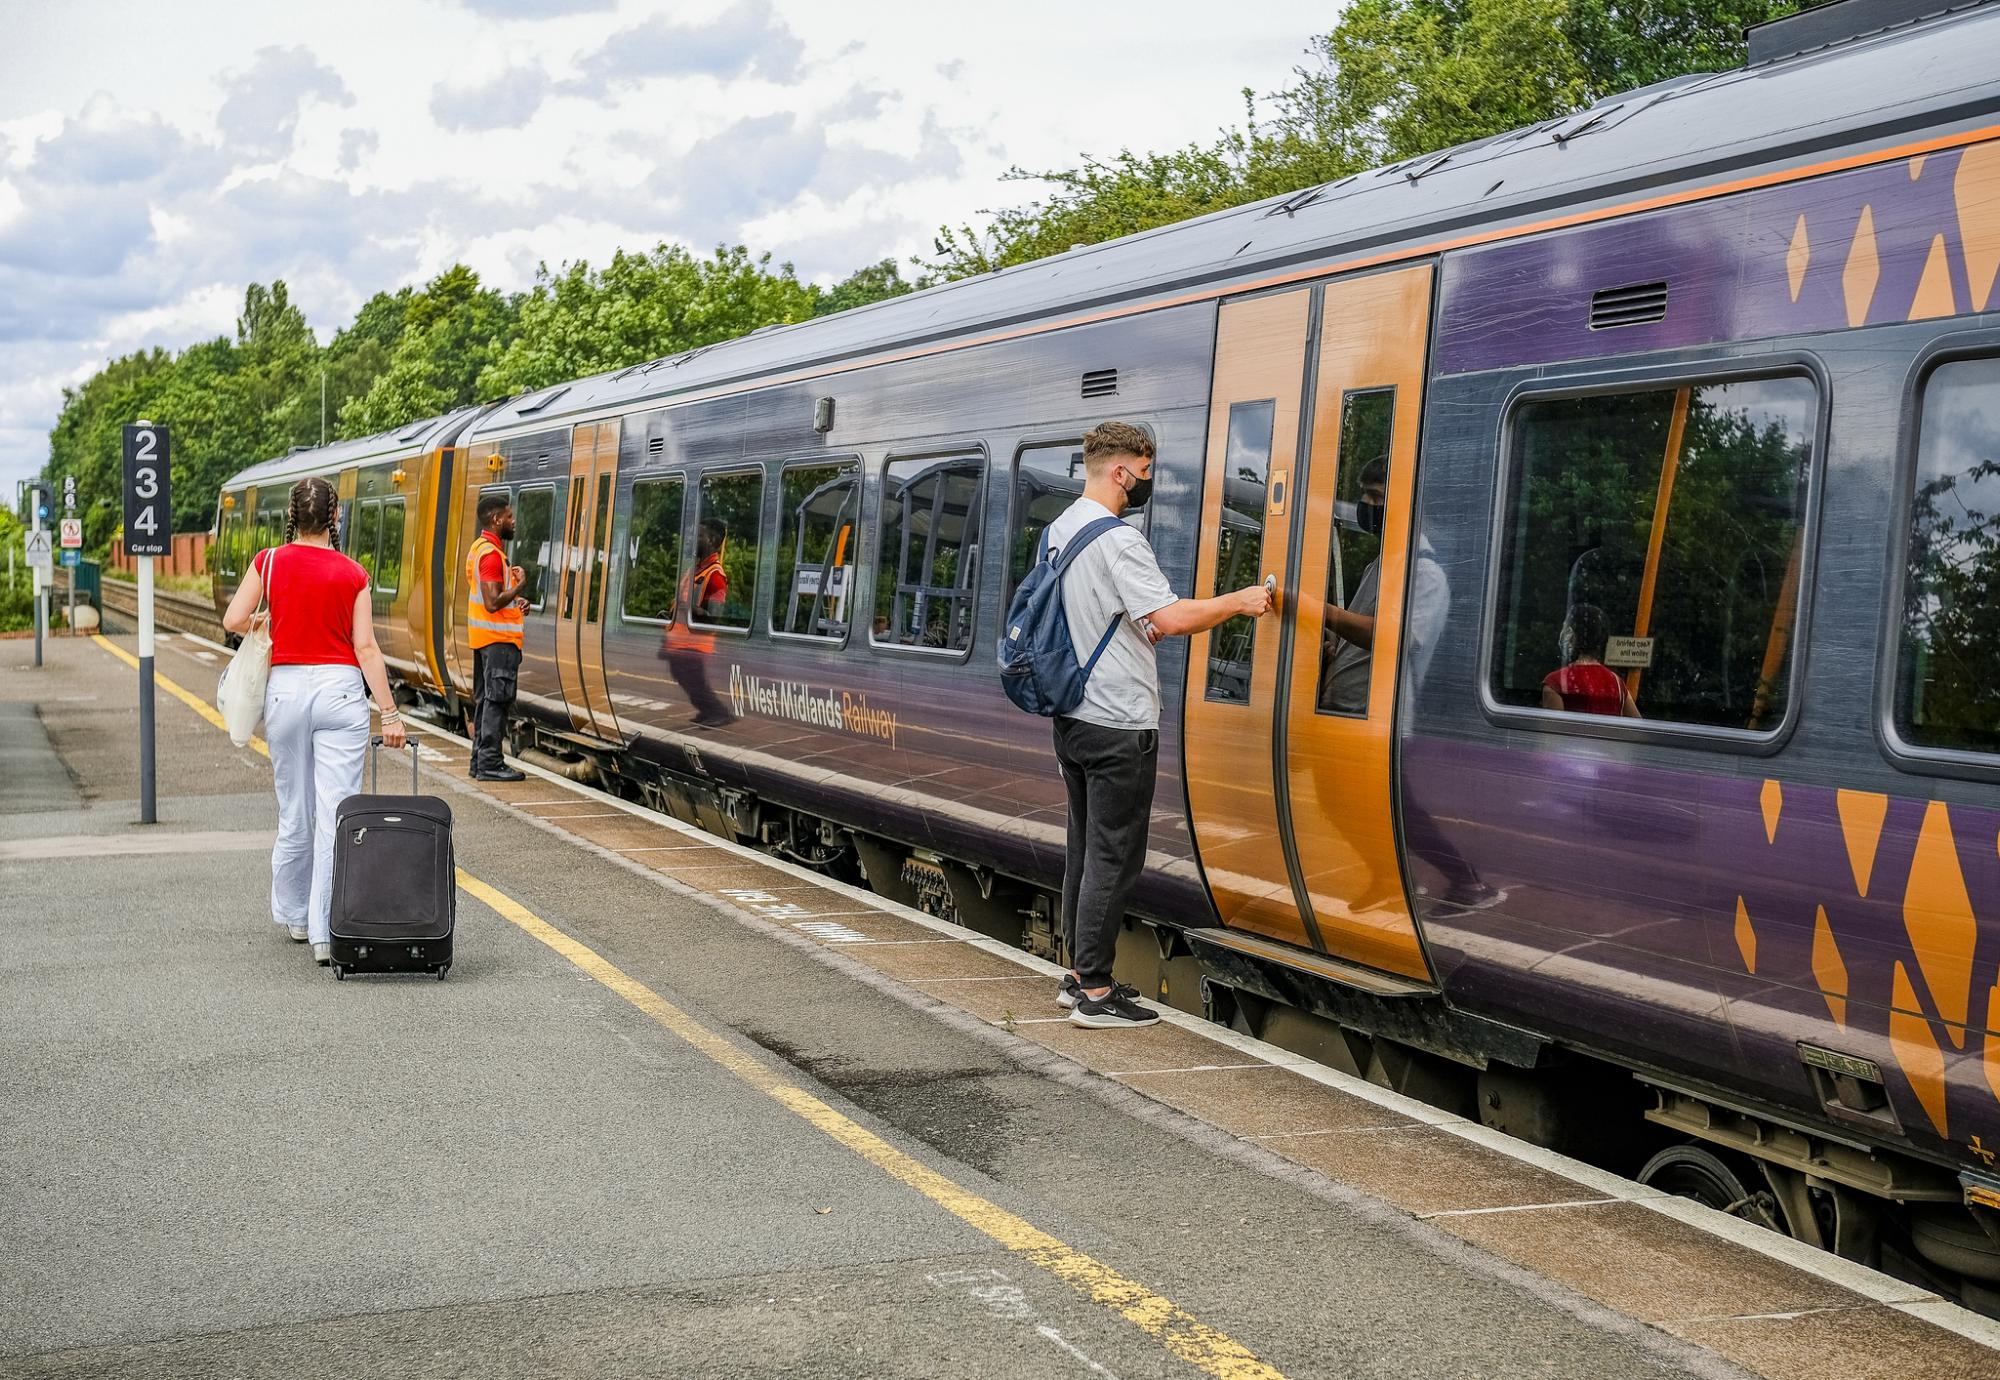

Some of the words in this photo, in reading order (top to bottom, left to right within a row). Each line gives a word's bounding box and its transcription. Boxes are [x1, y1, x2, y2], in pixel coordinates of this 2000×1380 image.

[135, 429, 158, 461] 2
[135, 467, 159, 499] 3
[65, 493, 75, 506] 6
[134, 505, 159, 536] 4
[131, 543, 145, 552] Car
[146, 543, 163, 553] stop
[746, 675, 780, 717] West
[780, 680, 842, 730] Midlands
[842, 692, 897, 750] Railway
[750, 903, 812, 920] THE
[790, 921, 876, 942] MIND
